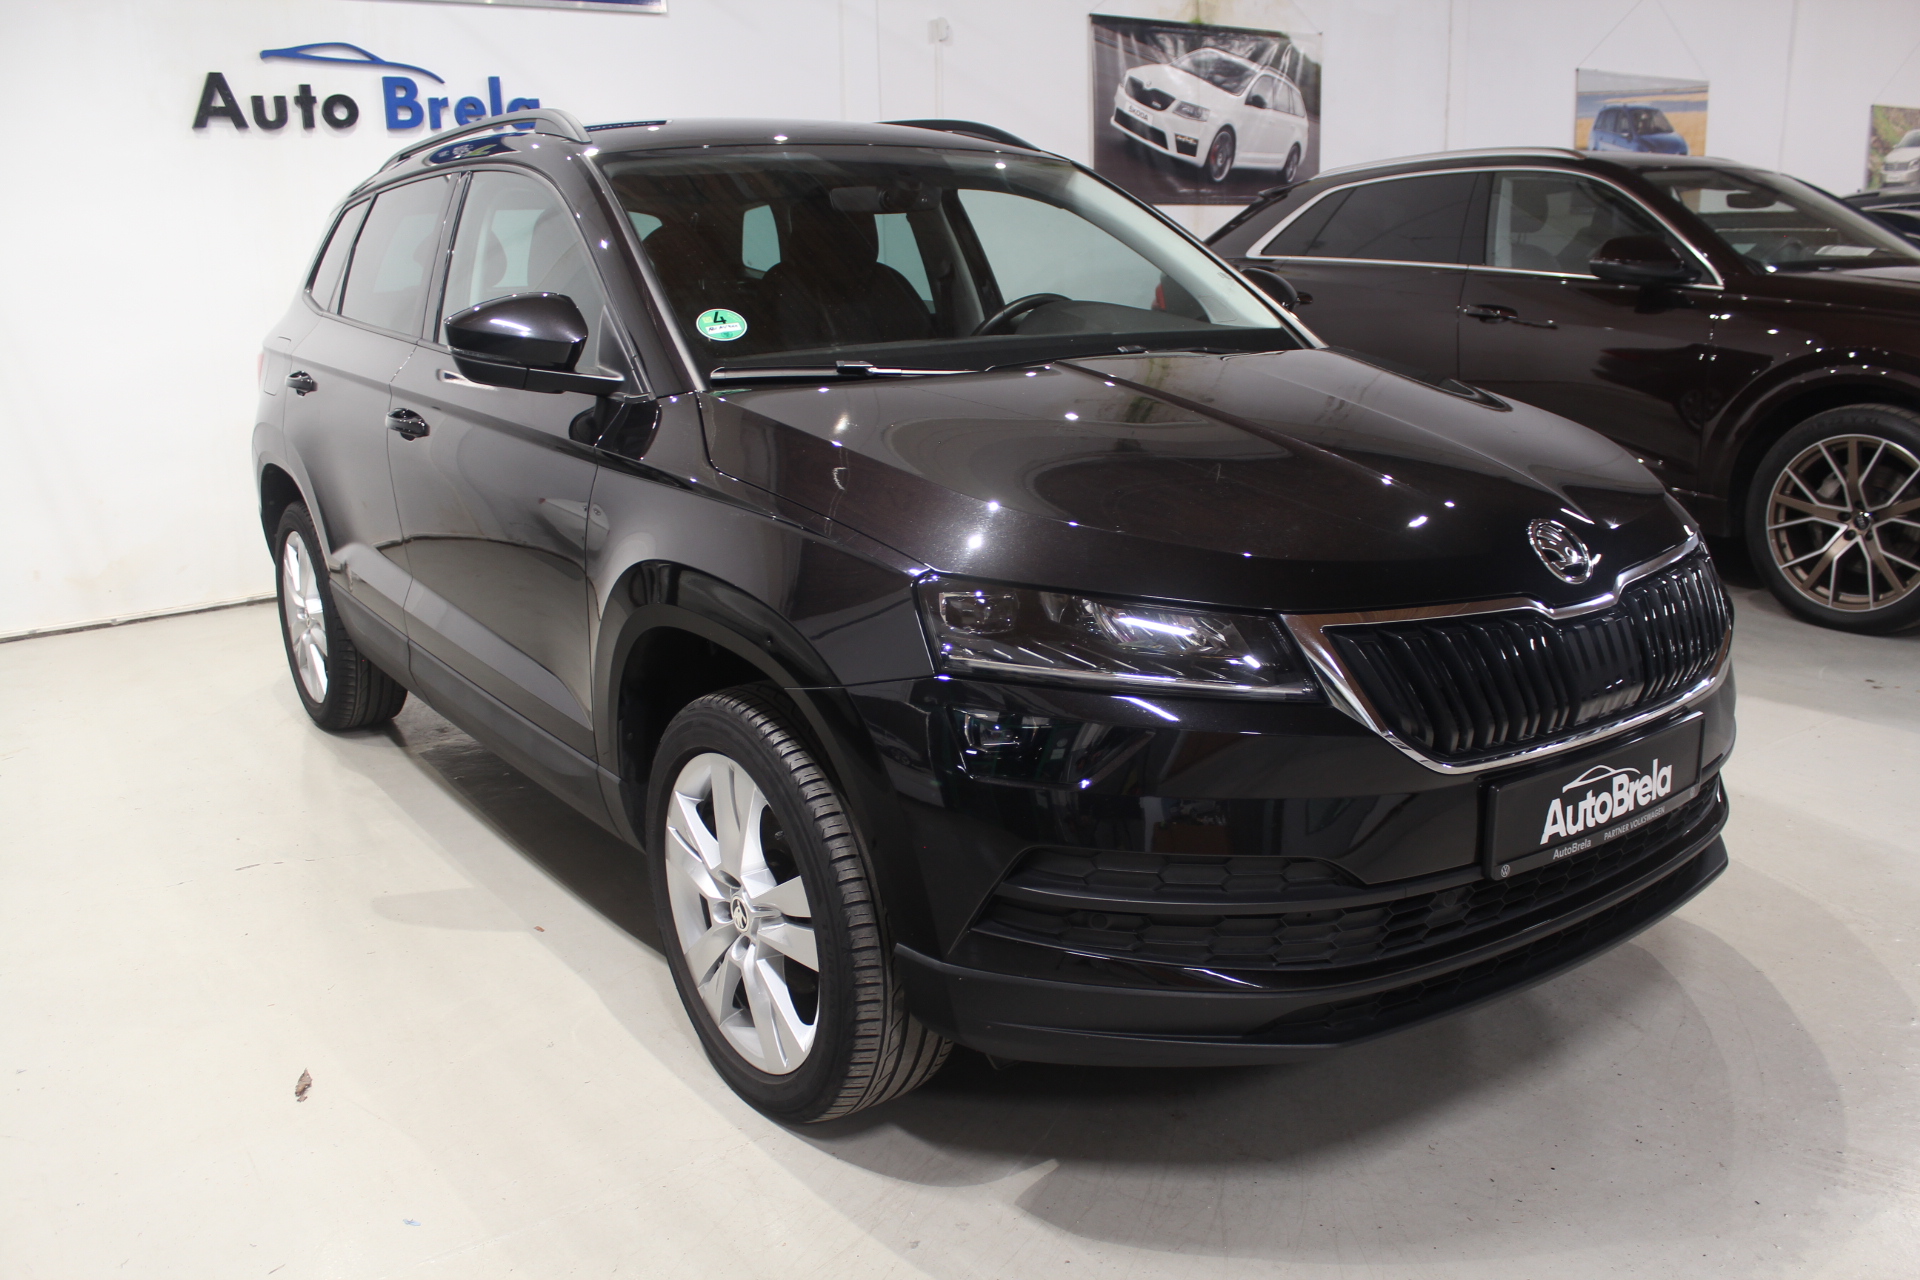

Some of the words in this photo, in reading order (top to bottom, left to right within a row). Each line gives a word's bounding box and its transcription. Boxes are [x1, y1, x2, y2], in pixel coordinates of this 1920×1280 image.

[192, 72, 359, 129] Auto
[713, 311, 727, 324] 4
[1540, 758, 1673, 845] AutoBrela
[1553, 838, 1592, 860] AutoBrela
[1603, 823, 1630, 841] PARTNER
[1630, 805, 1666, 829] VOLKSWAGEN
